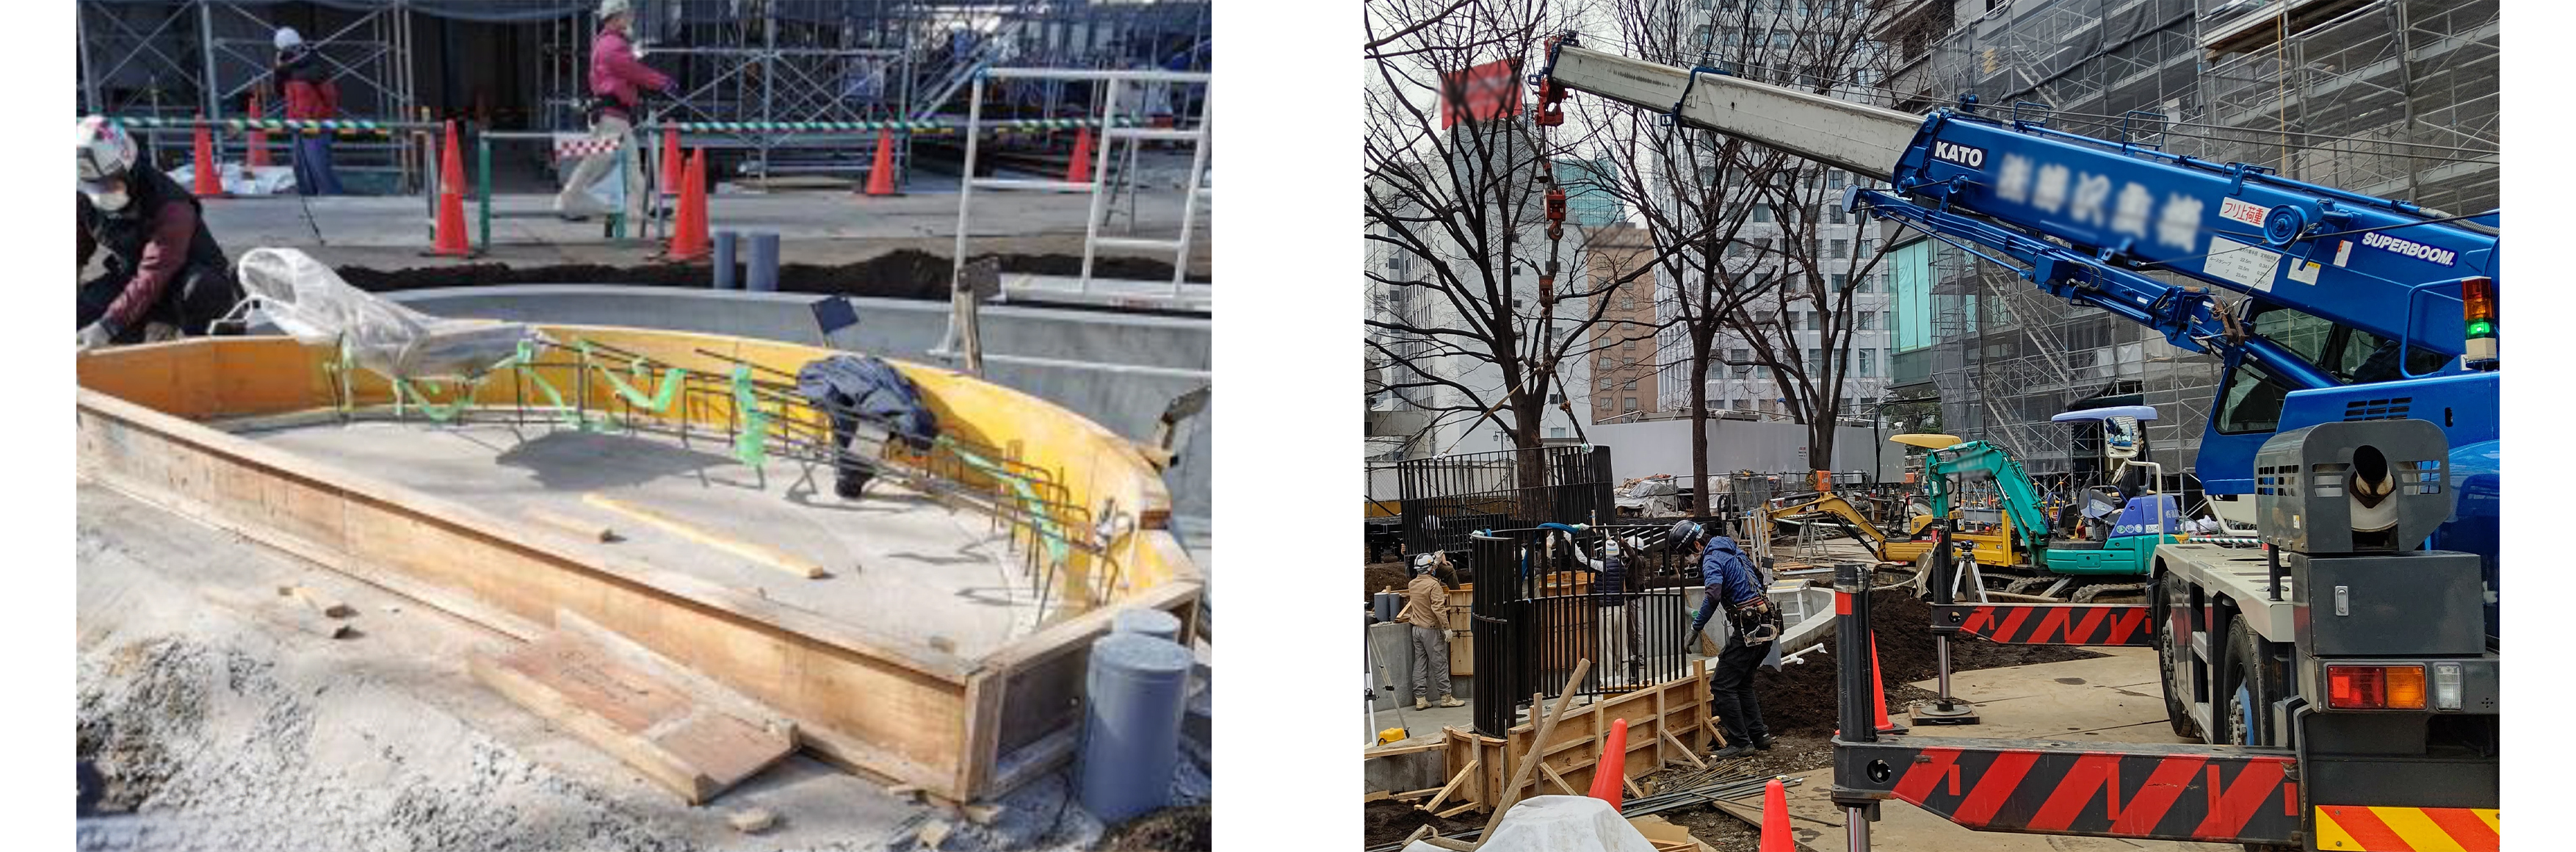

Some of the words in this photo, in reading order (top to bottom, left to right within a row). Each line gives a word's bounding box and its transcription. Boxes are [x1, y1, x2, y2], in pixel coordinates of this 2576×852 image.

[1935, 141, 1983, 167] KATO
[2224, 203, 2264, 225] フリ上荷重
